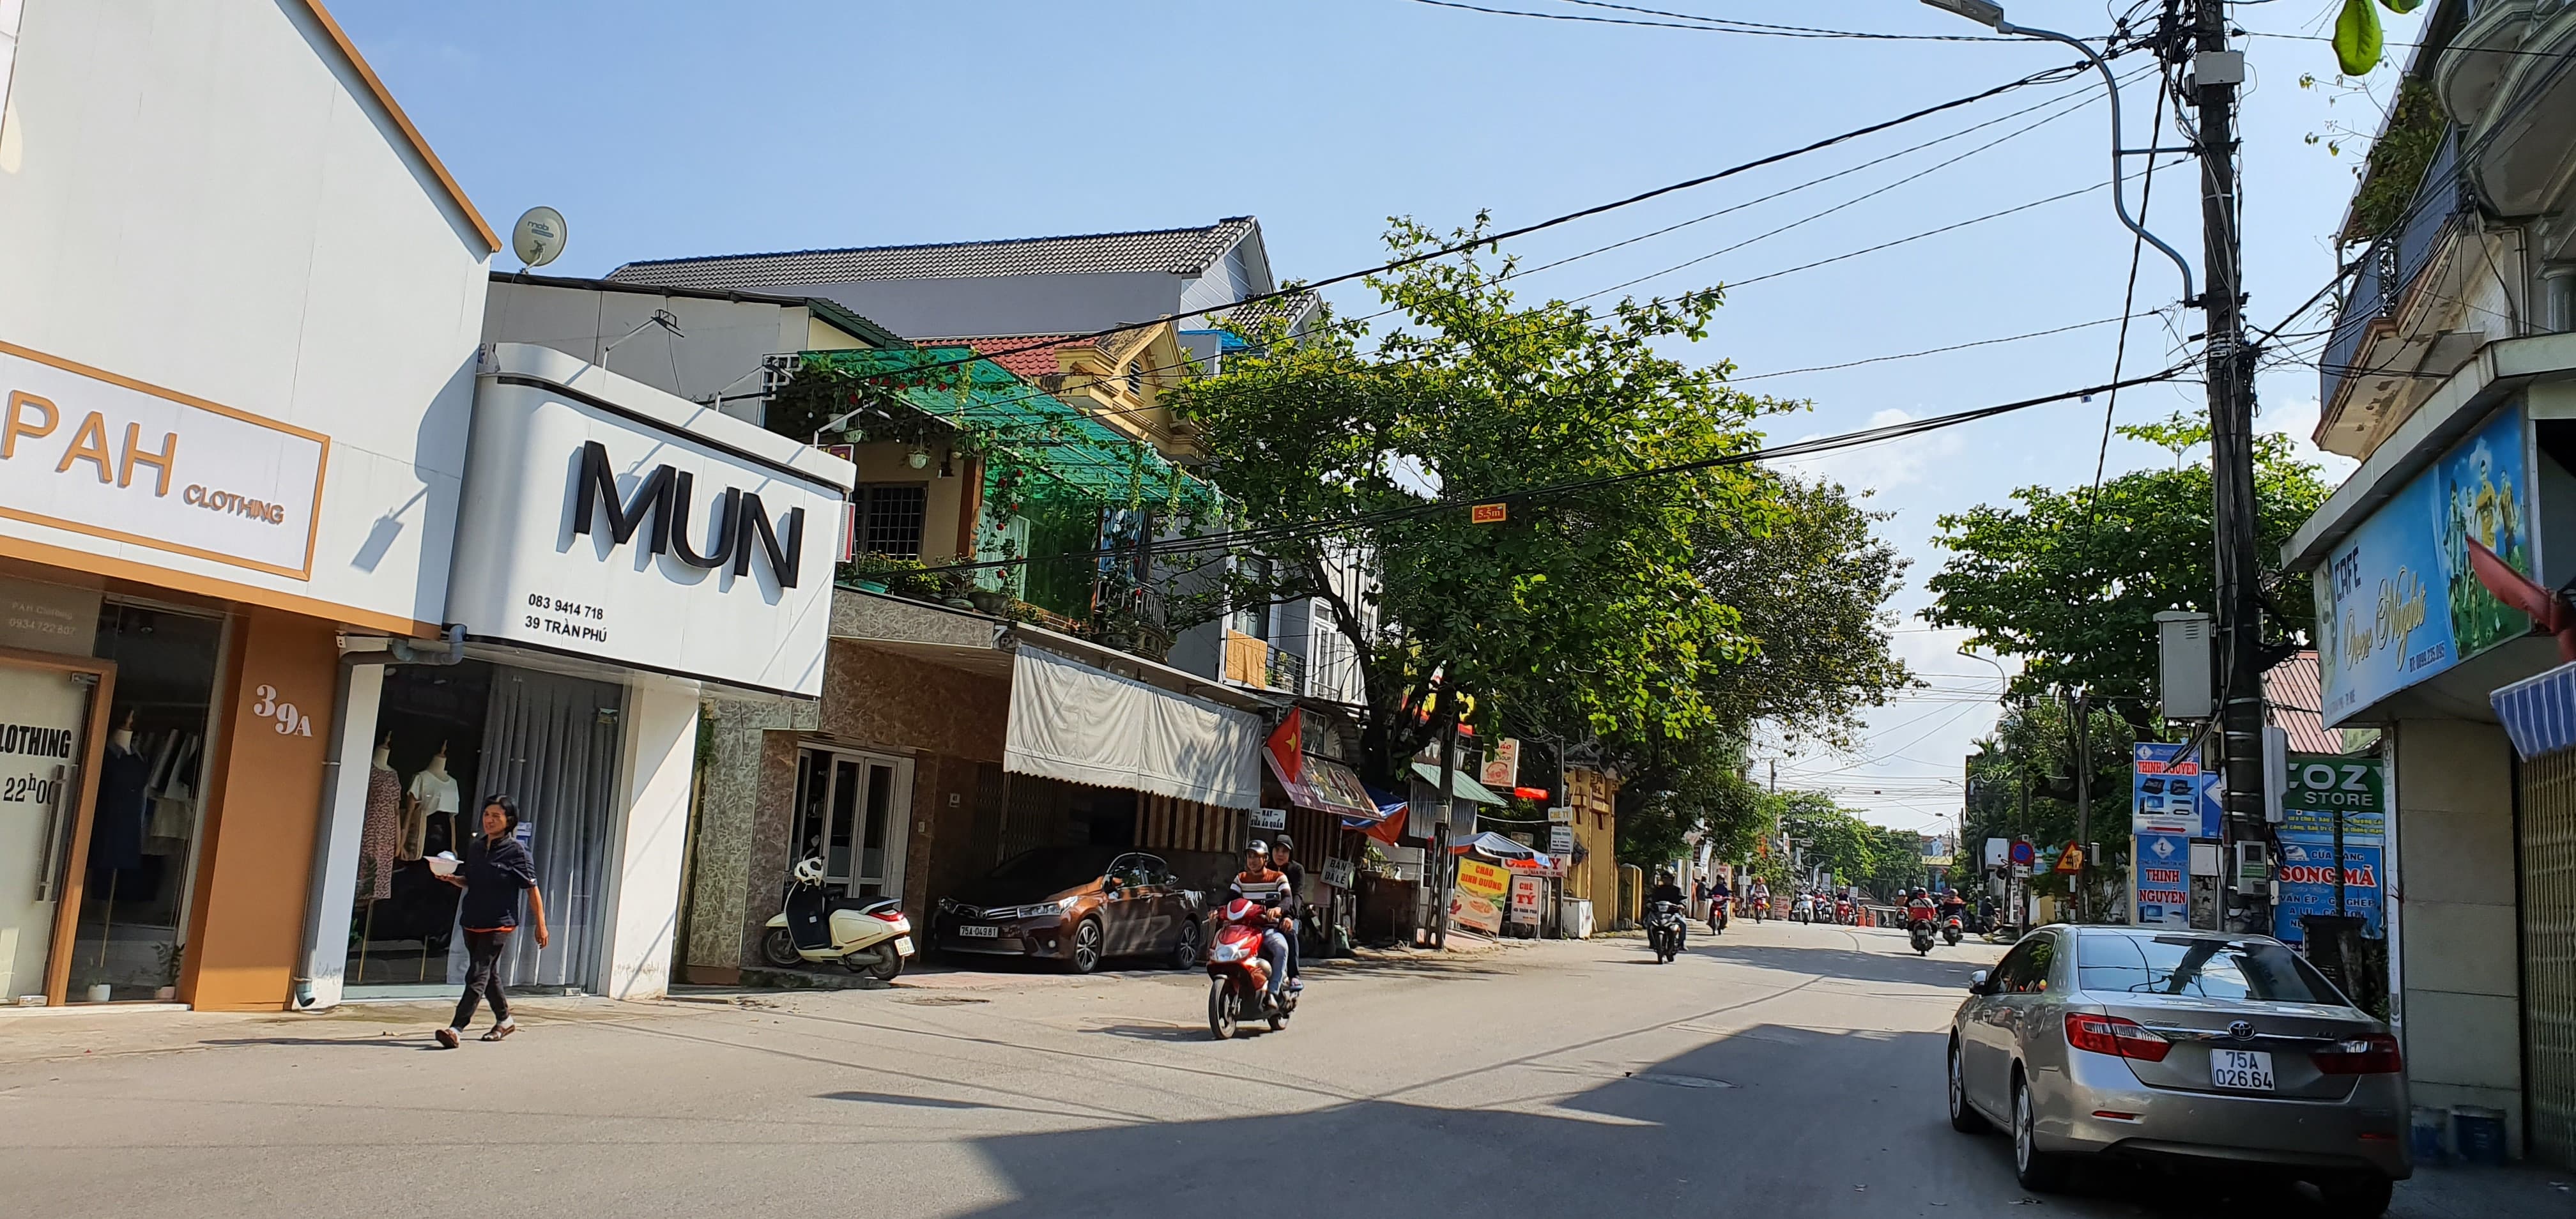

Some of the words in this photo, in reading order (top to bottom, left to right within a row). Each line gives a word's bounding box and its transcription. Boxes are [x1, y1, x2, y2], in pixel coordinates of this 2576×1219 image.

[0, 390, 178, 498] PAH
[183, 484, 284, 525] CLOTHING
[574, 440, 805, 589] MUN
[528, 594, 550, 609] 083
[555, 599, 581, 616] 9414
[584, 605, 604, 620] 718
[525, 615, 540, 629] 39
[582, 627, 607, 643] PHÚ
[2304, 791, 2373, 806] STORE
[2280, 865, 2336, 884] SONG
[2343, 864, 2375, 885] MÃ
[2226, 1051, 2259, 1070] 75A
[2216, 1069, 2274, 1089] 026.64
